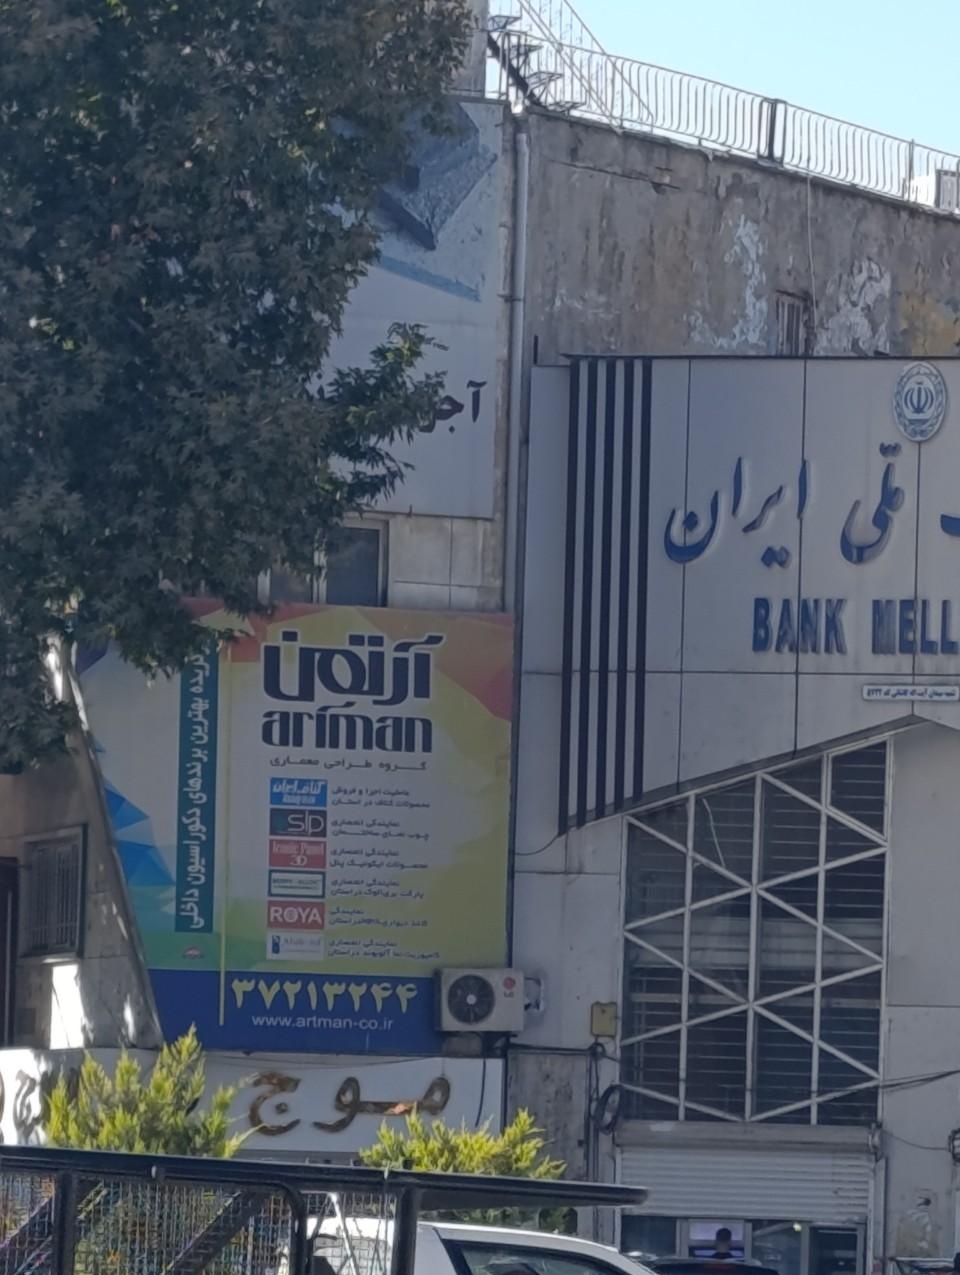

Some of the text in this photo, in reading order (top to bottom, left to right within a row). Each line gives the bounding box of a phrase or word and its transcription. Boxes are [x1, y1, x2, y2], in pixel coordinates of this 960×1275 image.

[663, 456, 812, 568] ایران
[752, 598, 846, 653] BANK
[270, 906, 323, 925] ROYA
[231, 979, 418, 1013] ۳۷۲۱۳۲۴۴
[251, 1015, 393, 1031] www.artman-co.ir
[248, 1071, 450, 1136] موج
